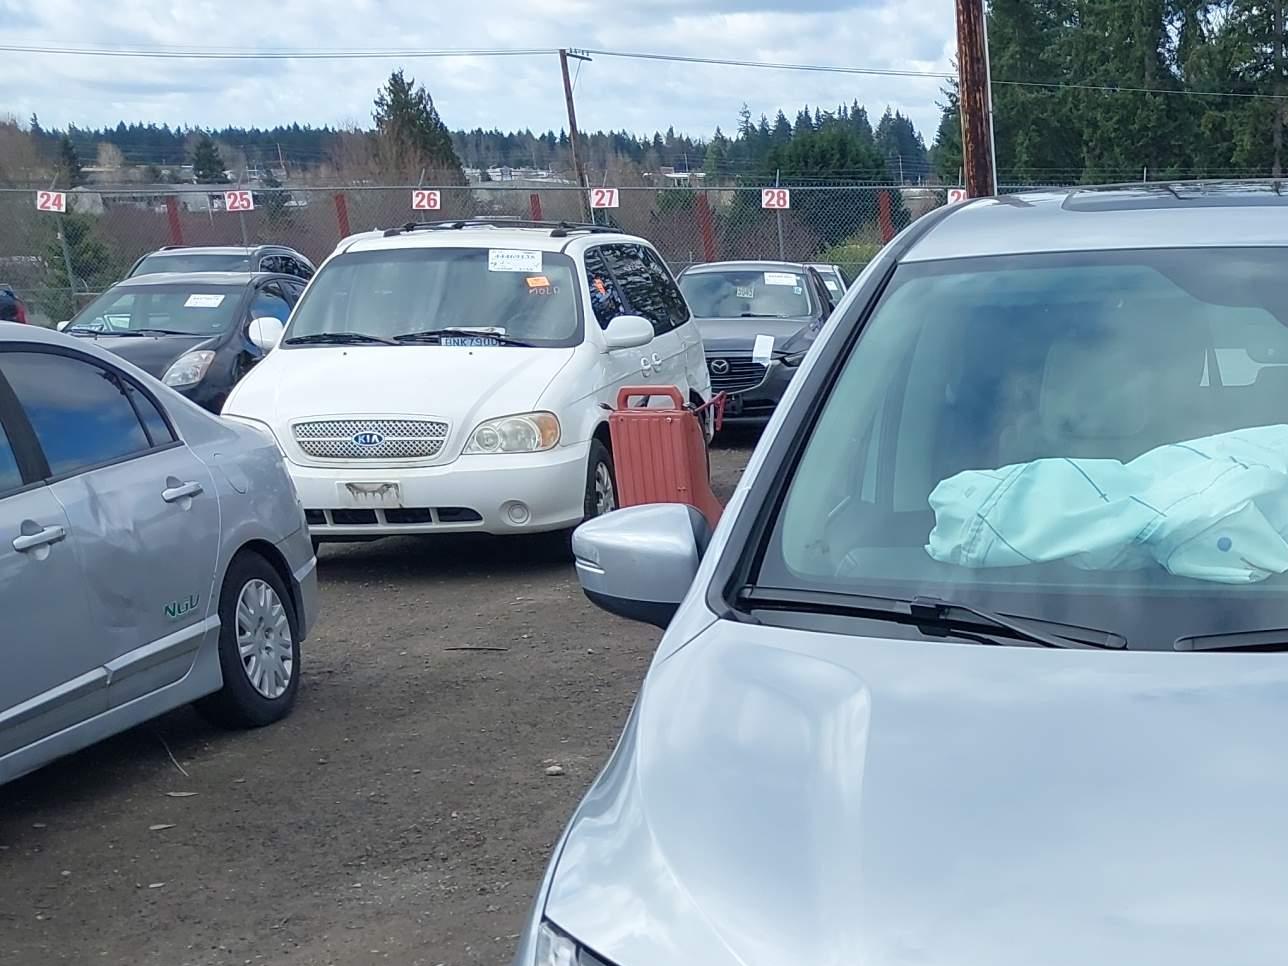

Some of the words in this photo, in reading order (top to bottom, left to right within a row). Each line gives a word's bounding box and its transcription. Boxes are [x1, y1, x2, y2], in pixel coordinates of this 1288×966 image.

[39, 192, 64, 210] 24
[228, 191, 251, 209] 25
[415, 191, 438, 208] 26
[595, 190, 615, 206] 27
[765, 190, 787, 208] 28
[358, 434, 380, 444] KIA
